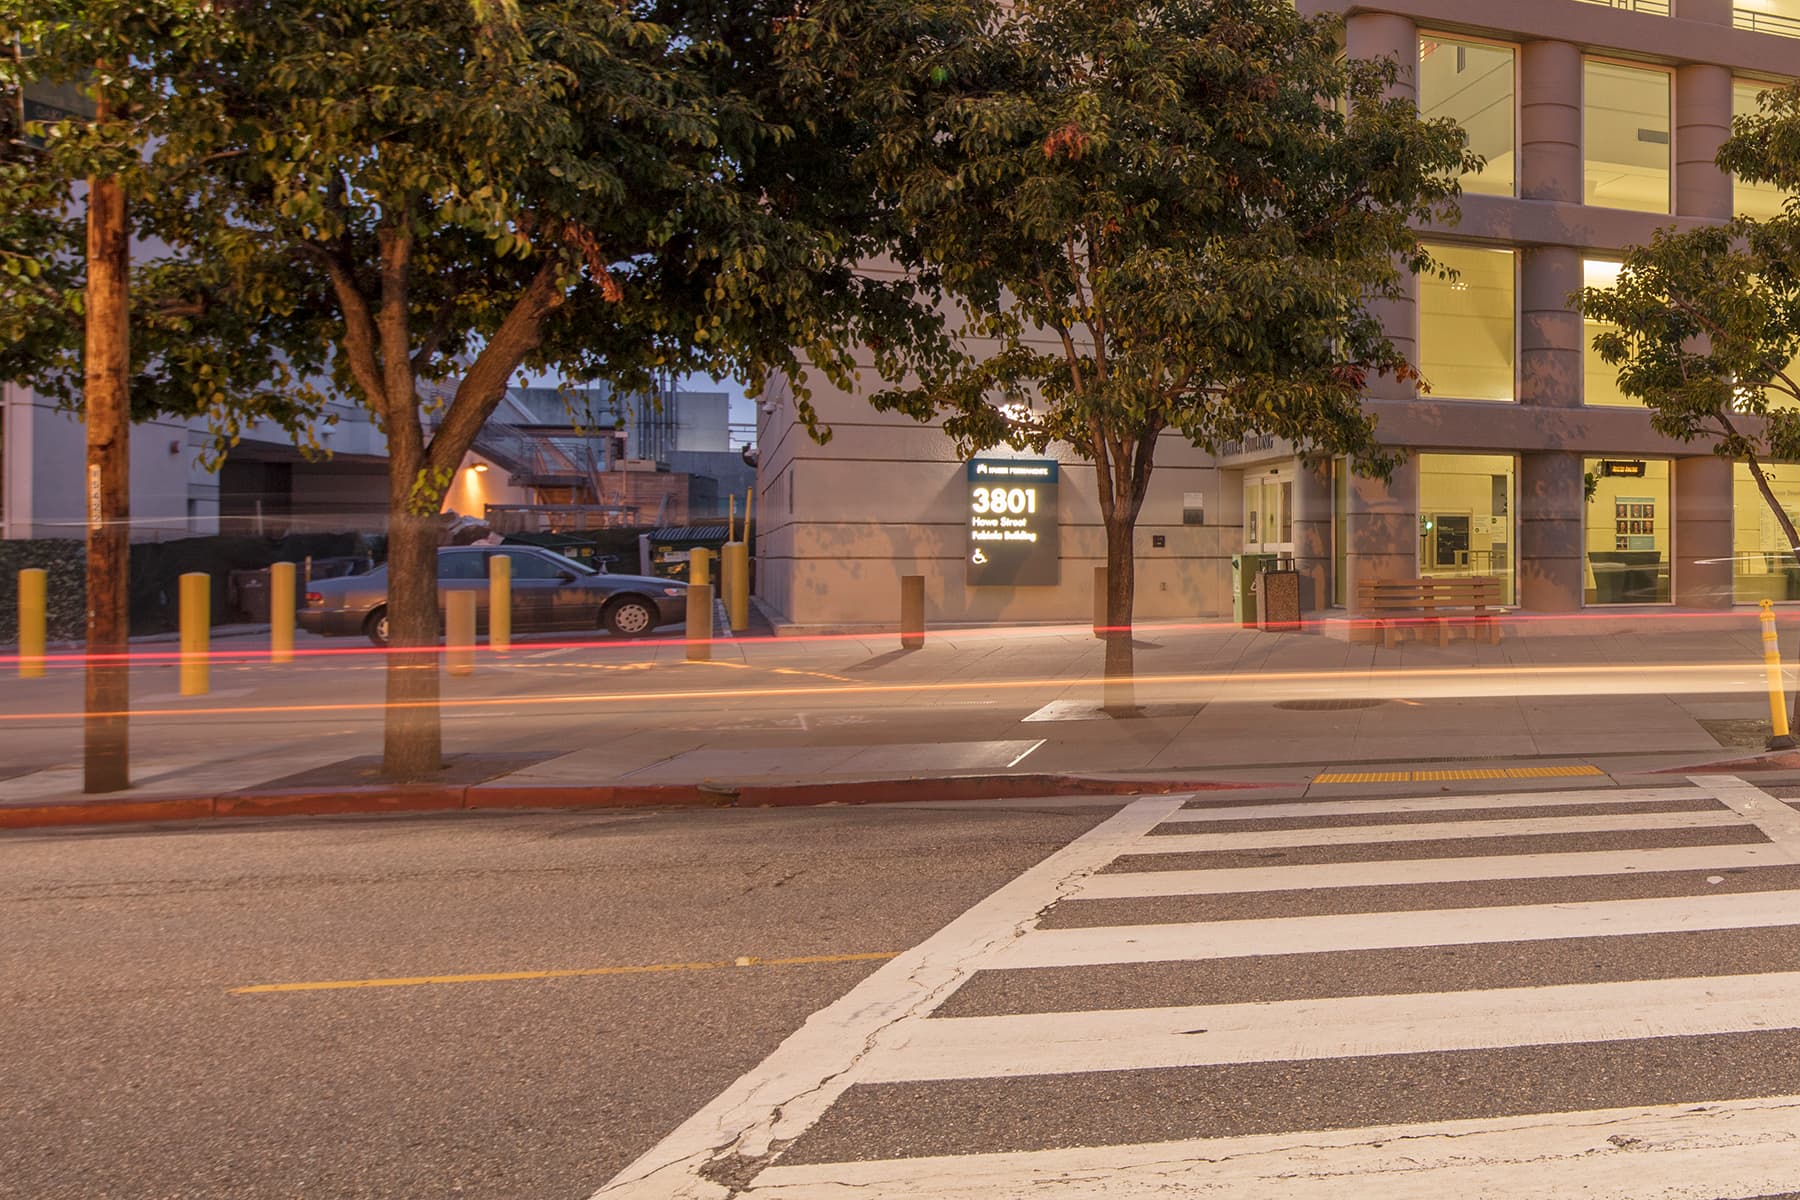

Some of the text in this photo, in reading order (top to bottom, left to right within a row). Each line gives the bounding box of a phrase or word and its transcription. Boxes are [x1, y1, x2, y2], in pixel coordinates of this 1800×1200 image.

[972, 487, 1036, 514] 3801
[972, 516, 1028, 528] Howe Street
